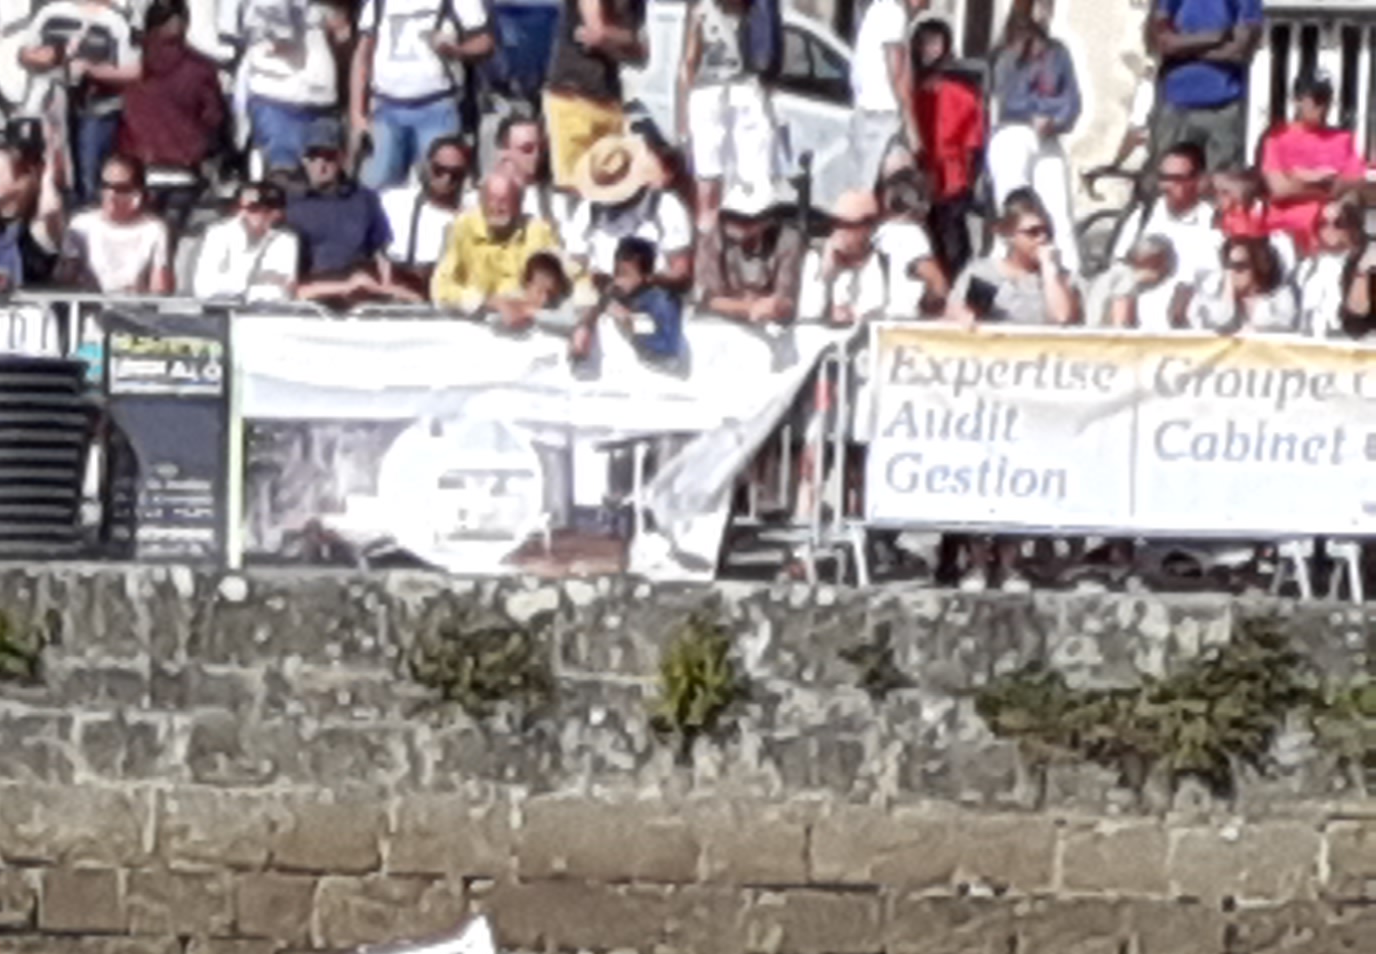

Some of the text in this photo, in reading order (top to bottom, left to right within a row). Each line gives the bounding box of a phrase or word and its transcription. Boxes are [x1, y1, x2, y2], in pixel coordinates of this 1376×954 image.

[888, 345, 1118, 396] Expertise
[1154, 356, 1336, 411] Groupe
[882, 402, 1019, 443] Audit
[1154, 418, 1346, 465] Cabinet
[884, 452, 1067, 501] Gestion
